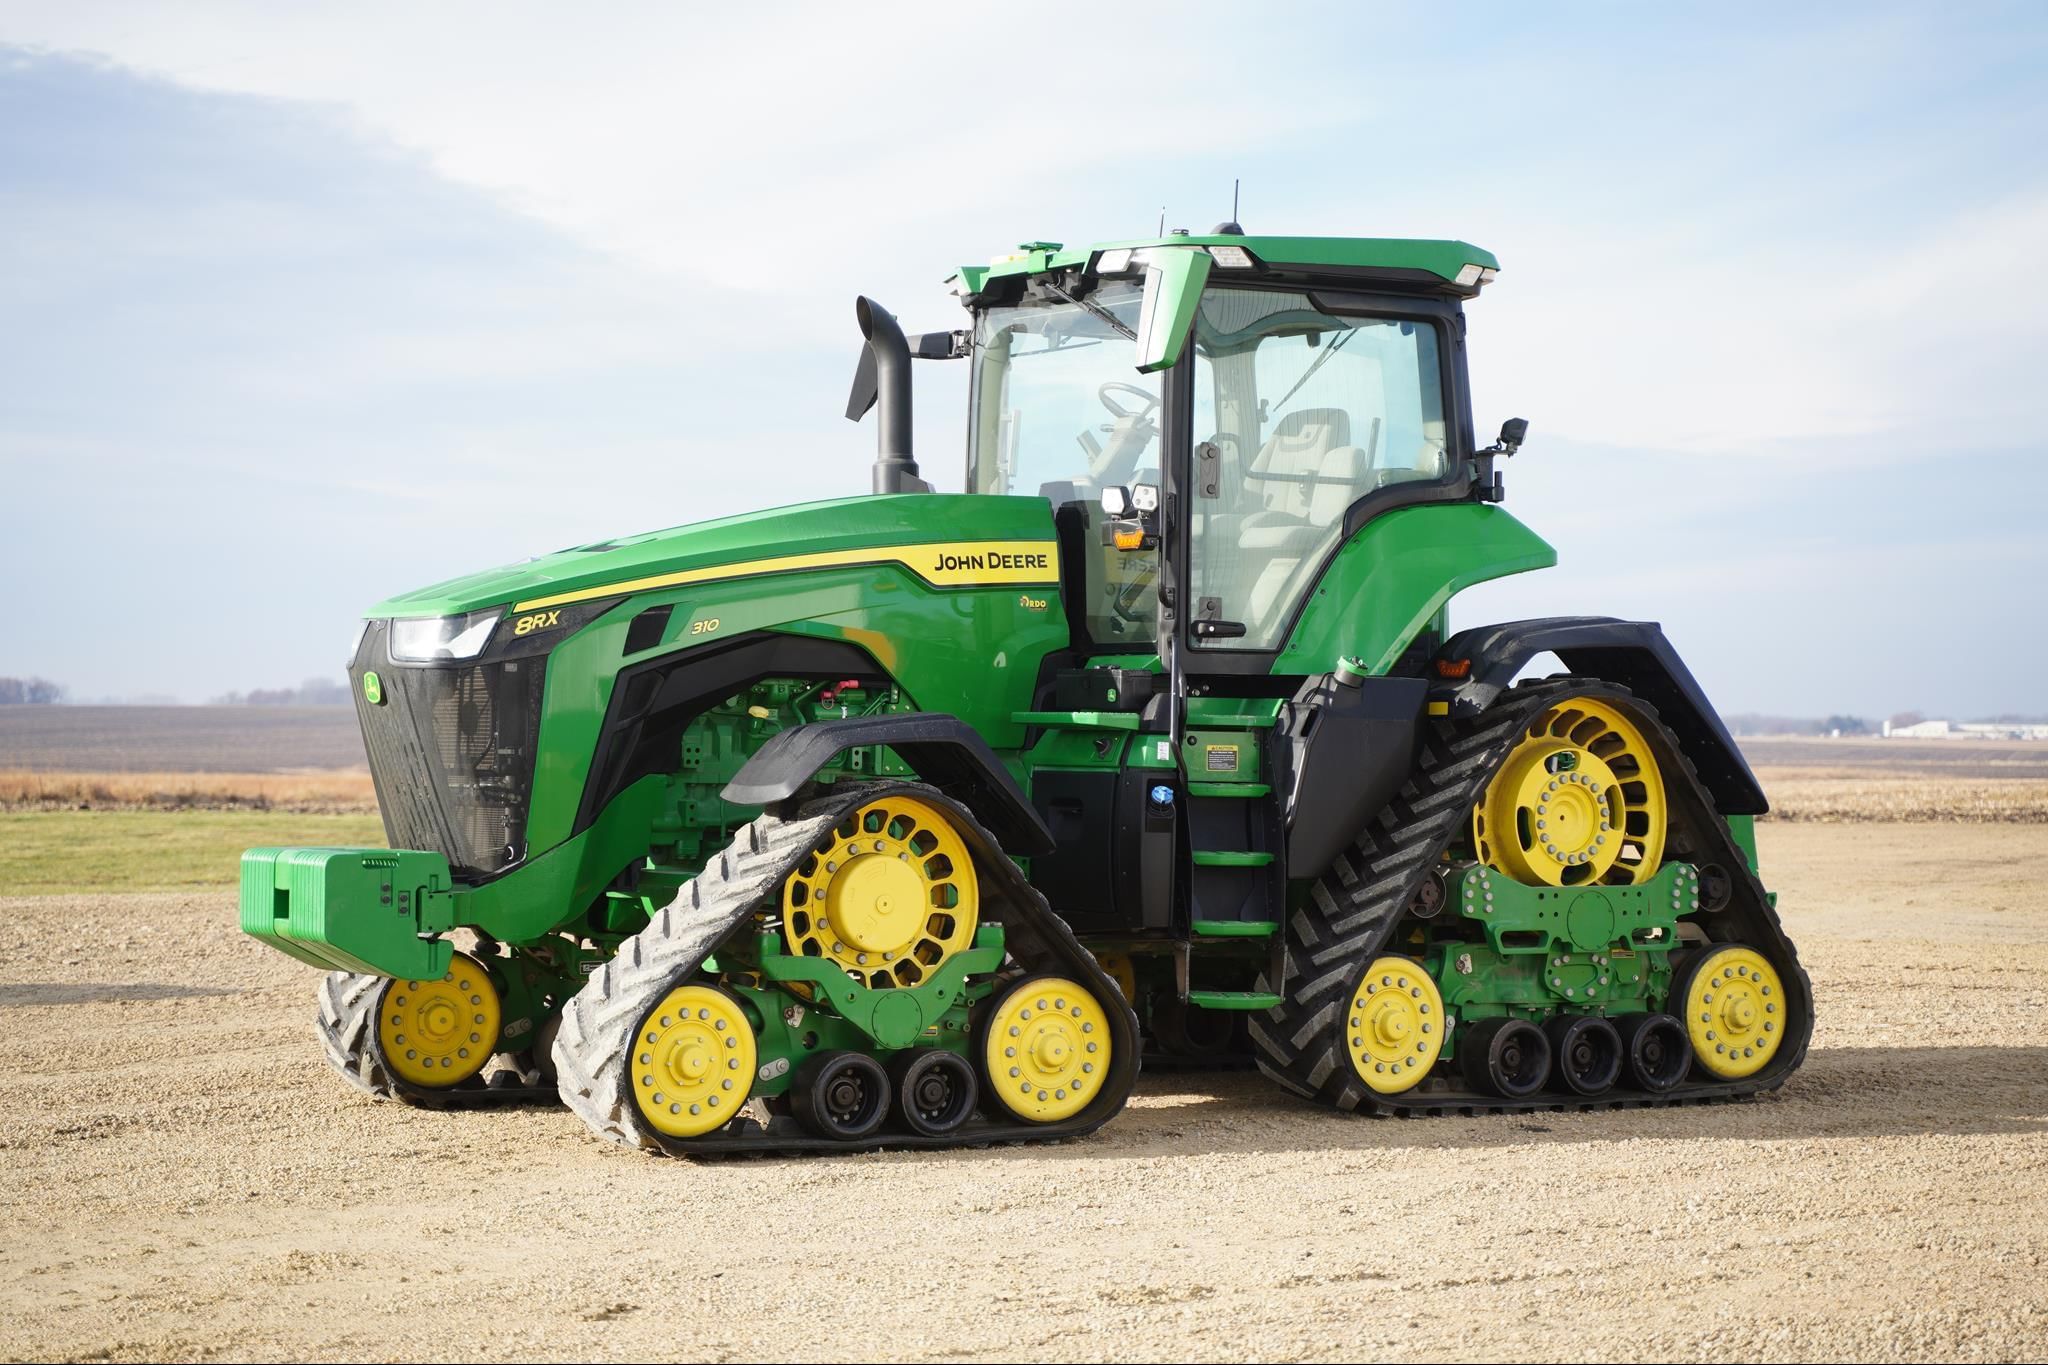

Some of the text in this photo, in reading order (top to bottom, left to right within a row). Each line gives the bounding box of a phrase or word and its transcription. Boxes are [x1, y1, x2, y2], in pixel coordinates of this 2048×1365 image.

[935, 552, 1048, 571] JOHN DEERE
[514, 610, 561, 636] 8RX
[691, 618, 720, 635] 310
